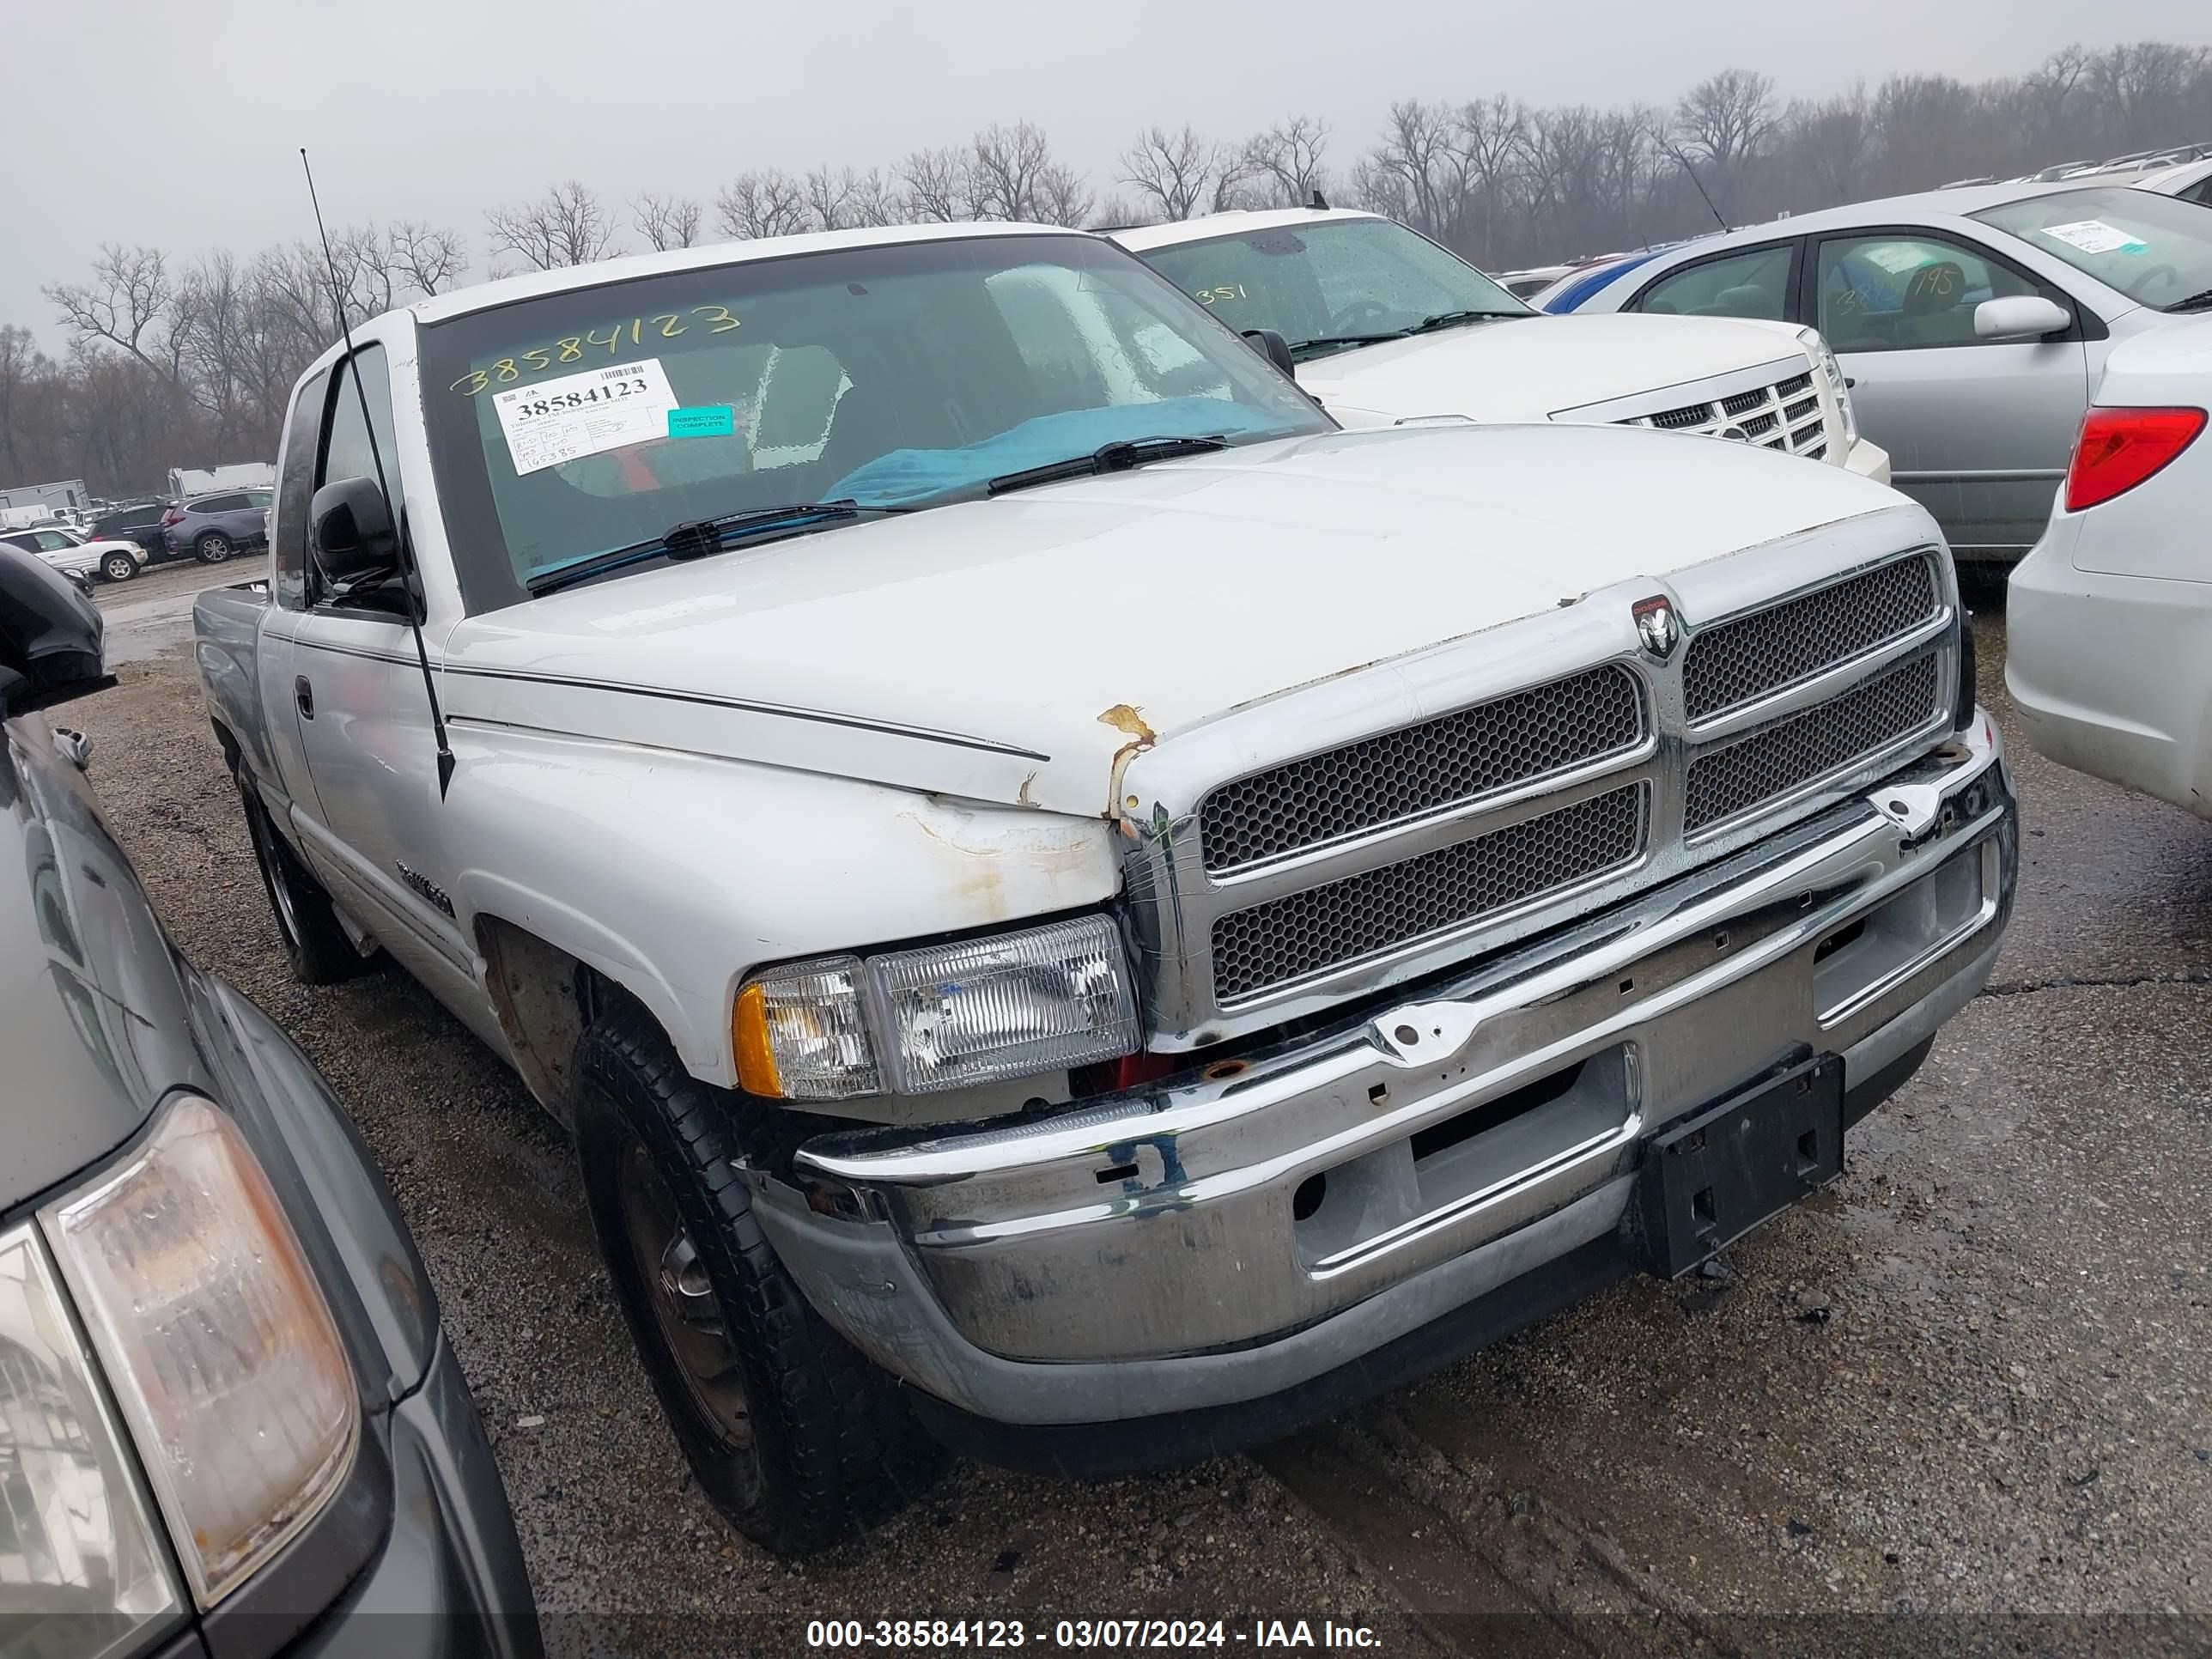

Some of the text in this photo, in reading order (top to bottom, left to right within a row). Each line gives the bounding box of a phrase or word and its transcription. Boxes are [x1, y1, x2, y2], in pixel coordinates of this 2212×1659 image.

[1195, 284, 1247, 305] 351
[448, 306, 742, 397] 38584123
[515, 379, 647, 421] 38584123
[672, 415, 726, 423] INSPECTION
[677, 421, 725, 429] COMPLETE
